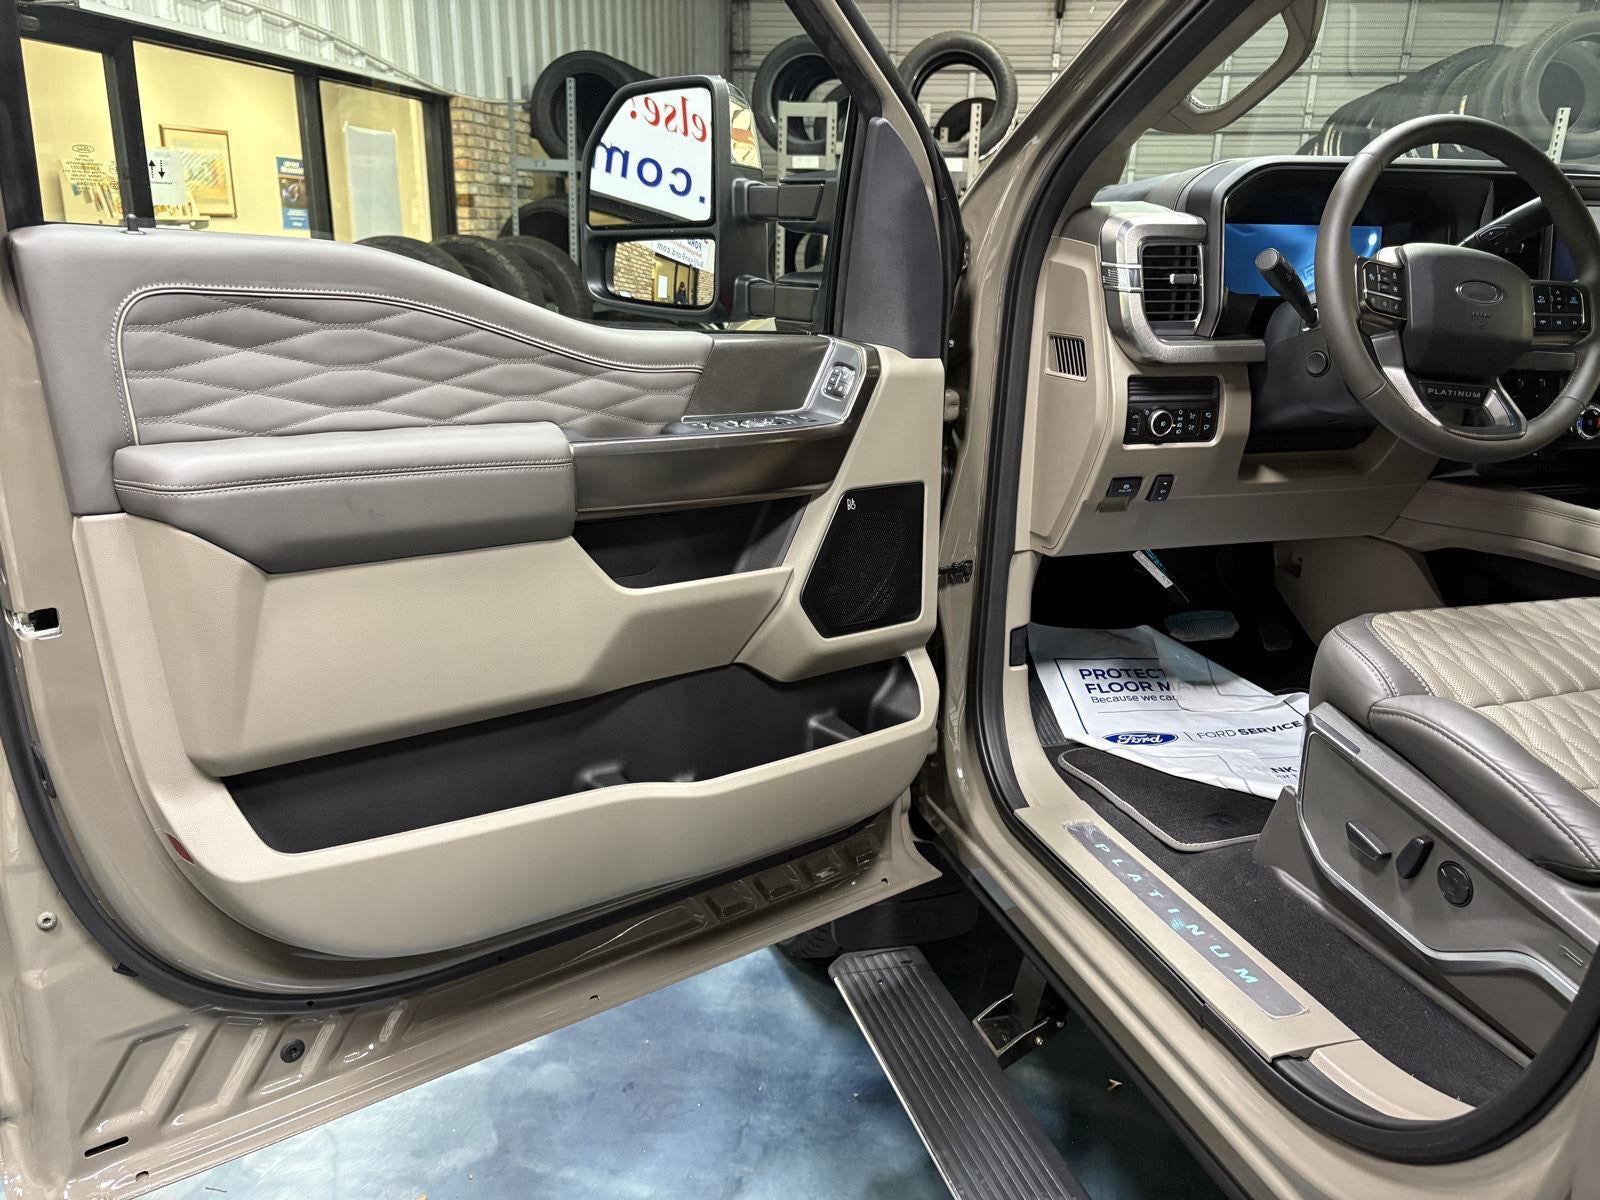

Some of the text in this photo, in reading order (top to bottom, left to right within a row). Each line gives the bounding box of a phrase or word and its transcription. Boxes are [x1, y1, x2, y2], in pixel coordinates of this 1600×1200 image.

[1428, 387, 1482, 399] PLATINUM
[1085, 681, 1153, 694] FLOOR
[1091, 695, 1139, 704] Because
[1197, 720, 1303, 739] FORD SERVICE
[1114, 733, 1166, 745] Ford
[1094, 842, 1259, 985] PLATINUM
